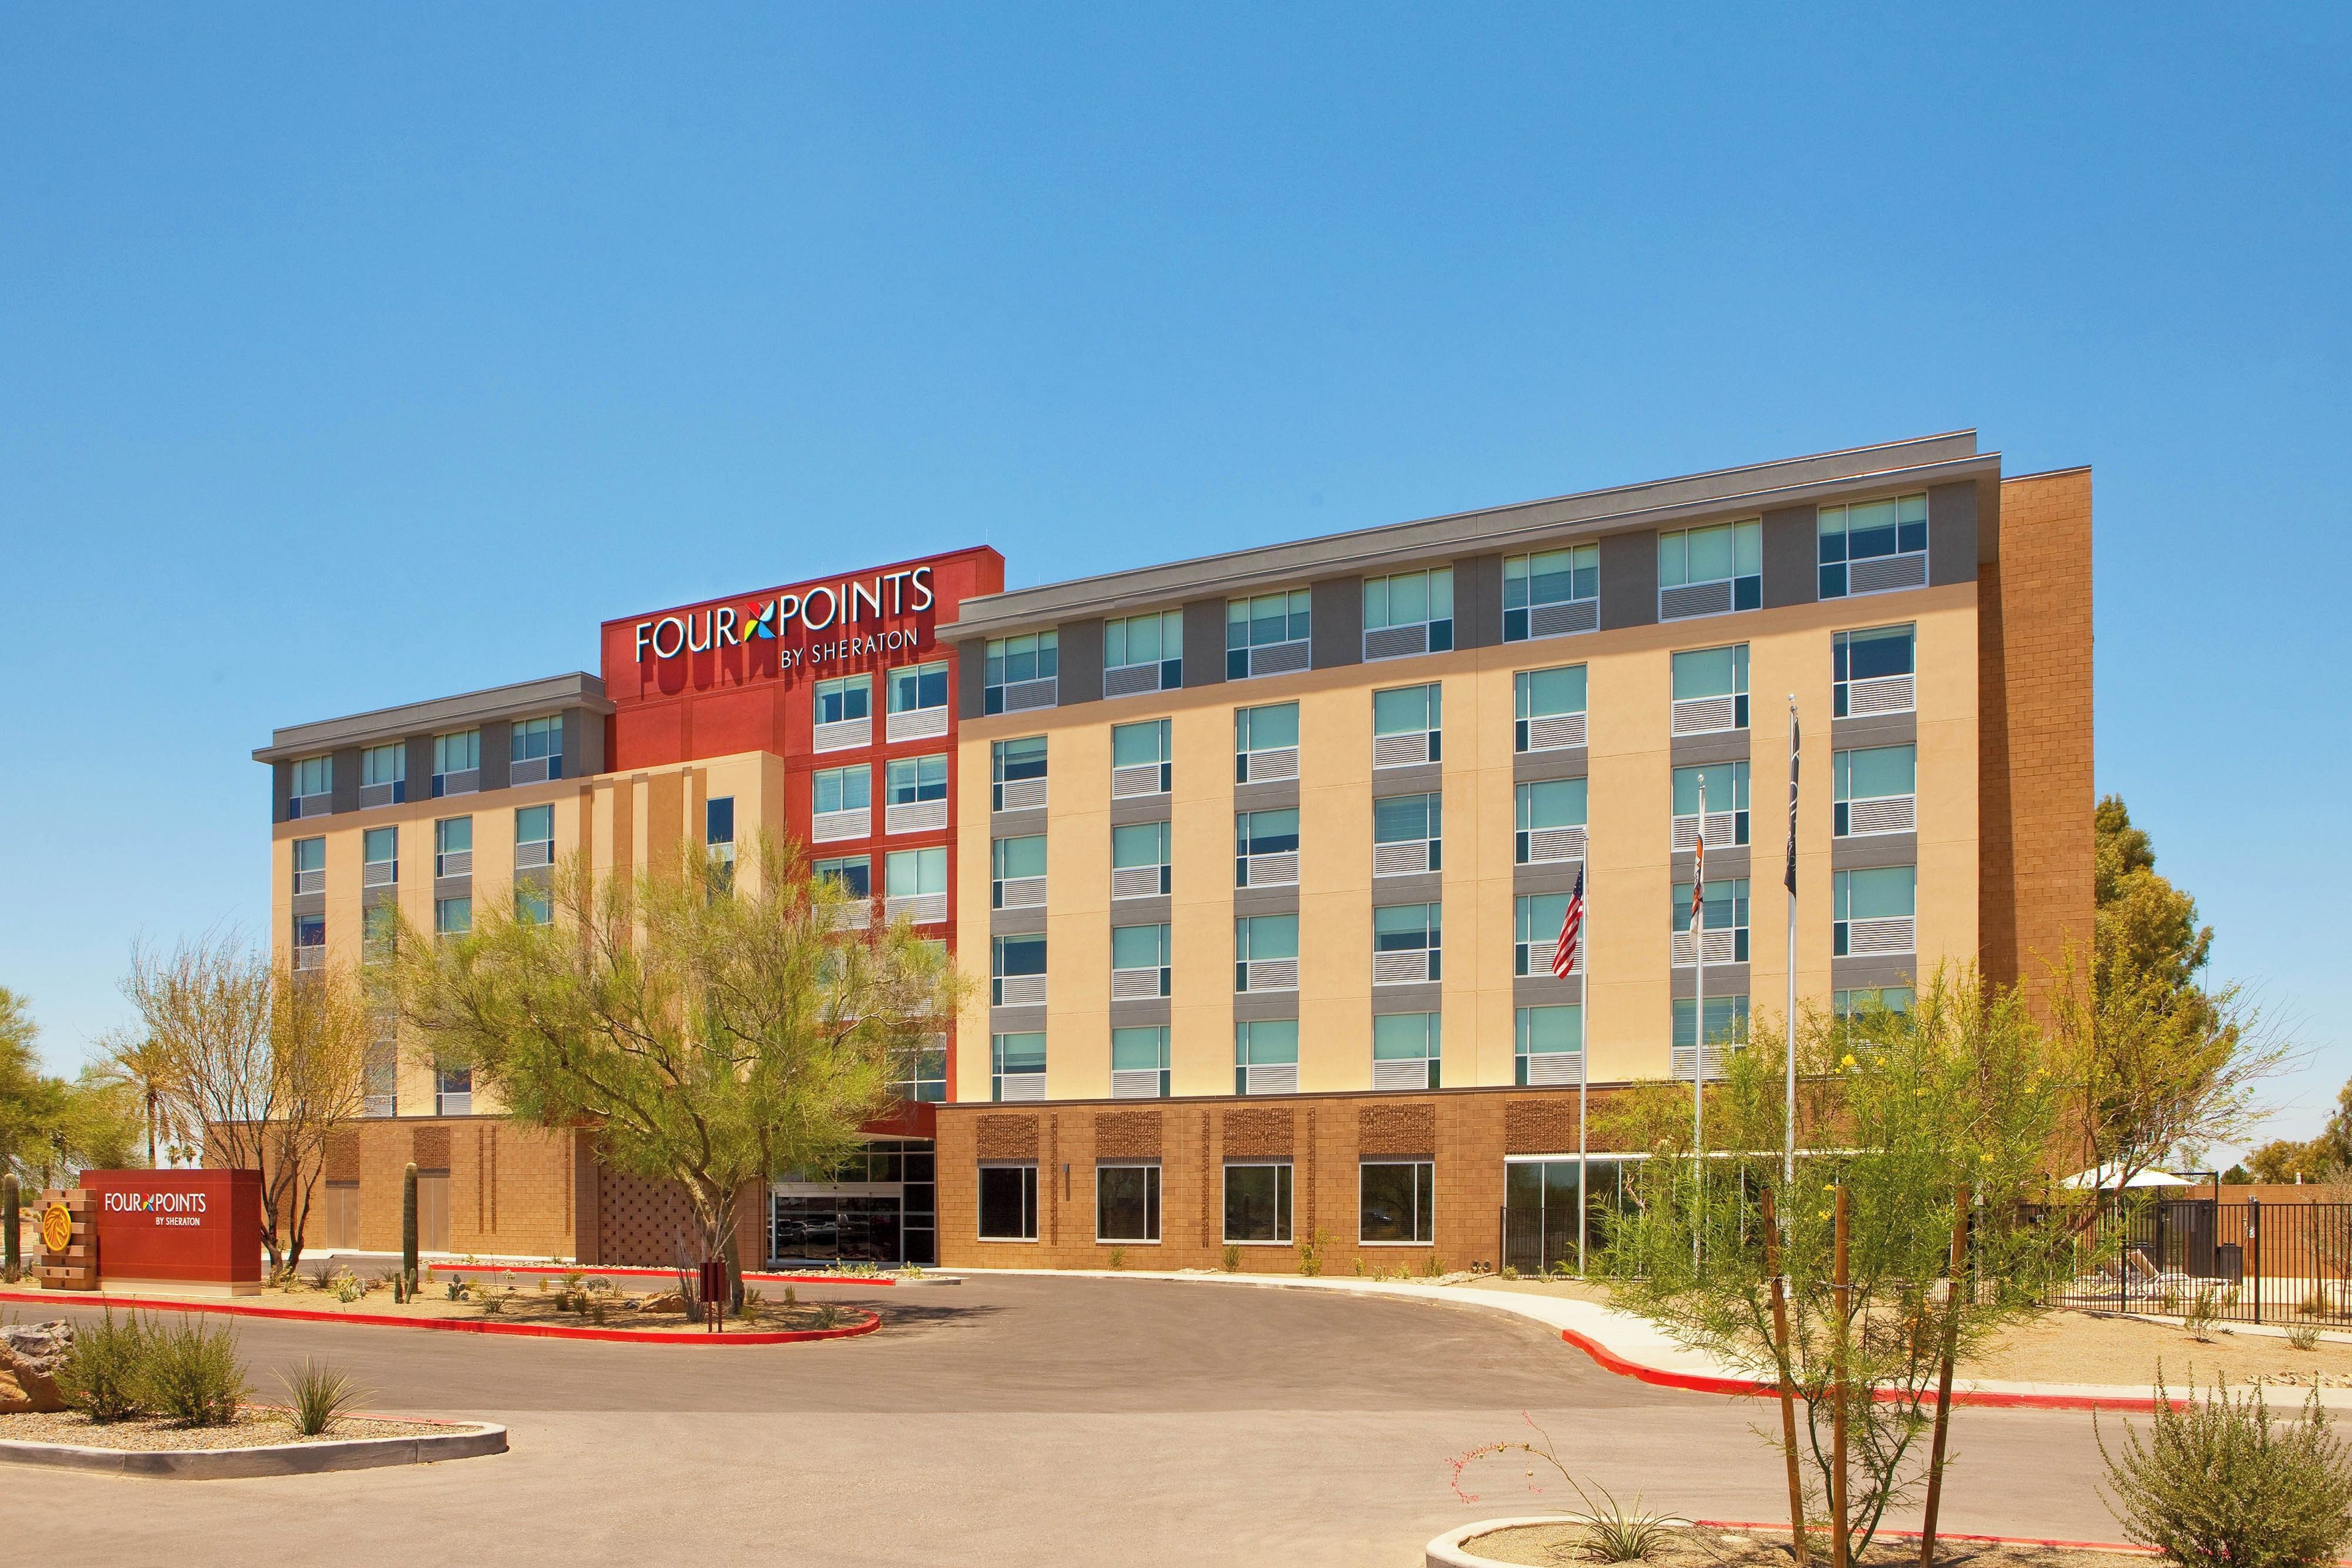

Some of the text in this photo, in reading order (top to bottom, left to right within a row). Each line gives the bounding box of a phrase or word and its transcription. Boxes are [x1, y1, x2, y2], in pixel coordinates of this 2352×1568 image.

[636, 567, 935, 663] FOUR POINTS
[781, 627, 919, 669] BY SHERATON
[105, 1193, 206, 1213] FOUR POINTS
[156, 1216, 200, 1226] BY SHERATON
